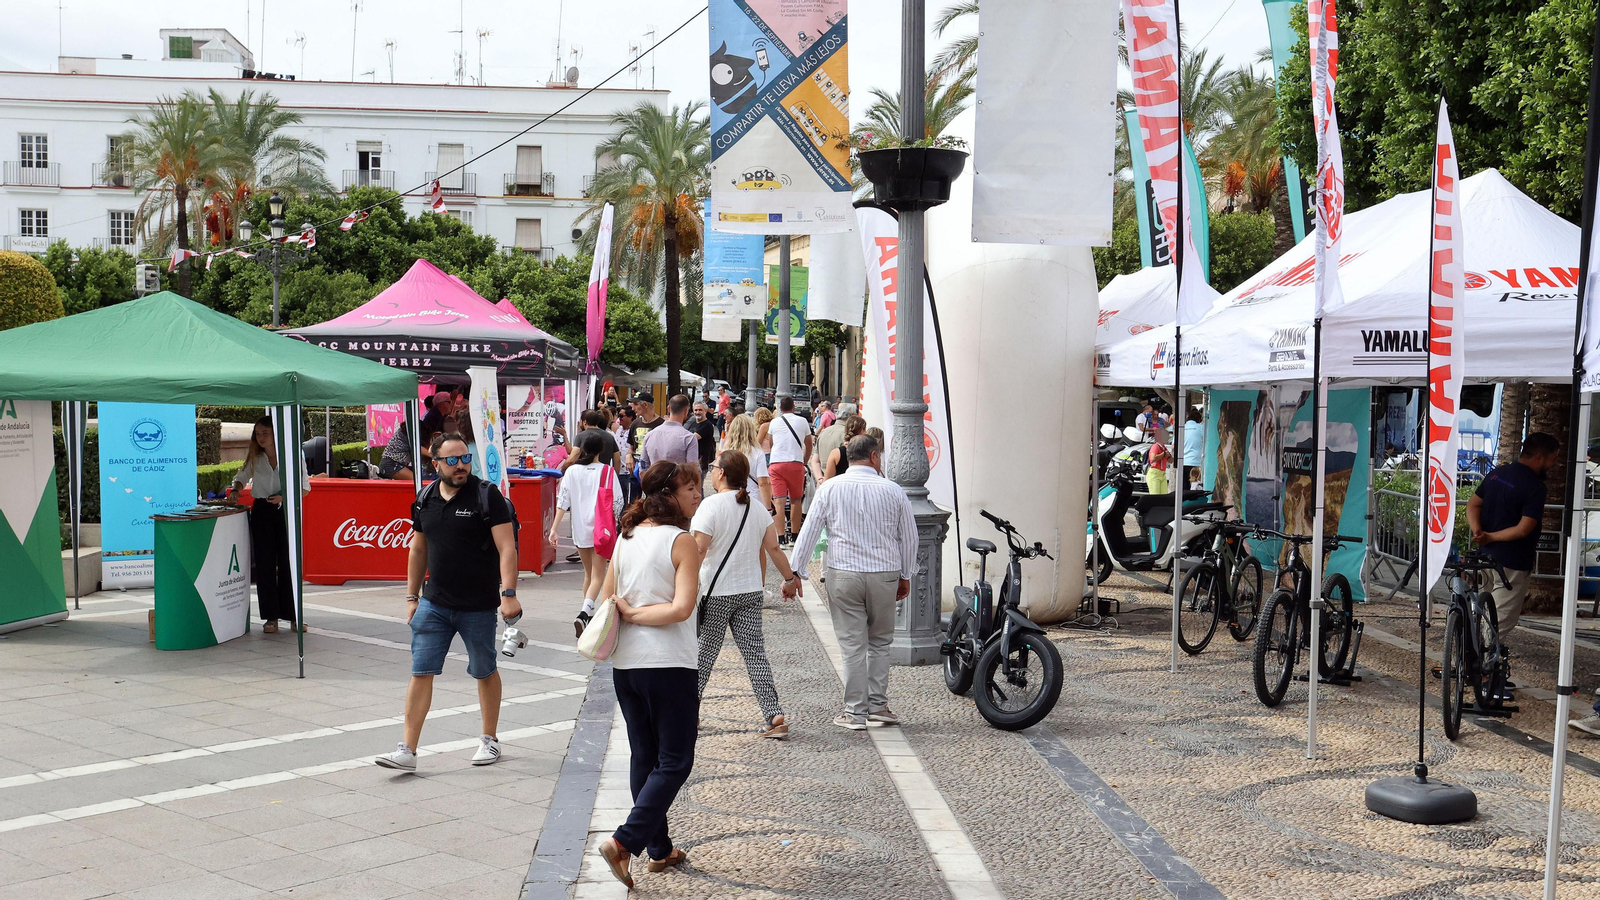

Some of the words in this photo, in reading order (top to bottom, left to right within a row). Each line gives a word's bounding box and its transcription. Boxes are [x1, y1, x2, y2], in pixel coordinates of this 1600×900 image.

[744, 6, 752, 14] 16
[752, 15, 762, 25] 22
[758, 22, 768, 33] DE
[765, 31, 794, 60] SEPTIEMBRE
[716, 102, 766, 149] COMPARTIR
[761, 92, 776, 105] TE
[772, 73, 800, 97] LLEVA
[797, 56, 818, 77] MÁS
[815, 34, 842, 60] LEJOS
[790, 121, 804, 139] Regalos
[802, 136, 811, 149] para
[809, 146, 819, 158] todos
[817, 156, 825, 165] los
[807, 152, 836, 185] www.jerez.es
[362, 312, 416, 320] Mountain
[418, 309, 443, 317] Bike
[444, 309, 470, 319] Jerez
[1276, 326, 1310, 349] YAMAHA
[318, 341, 339, 350] CC
[348, 341, 441, 353] MOUNTAIN
[450, 343, 492, 353] BIKE
[379, 357, 432, 367] JEREZ
[1166, 350, 1190, 368] Naarro
[7, 421, 30, 430] Andalucía
[144, 464, 165, 472] CÁDIZ
[164, 501, 193, 509] ayuda
[333, 518, 415, 548] Coca-Col
